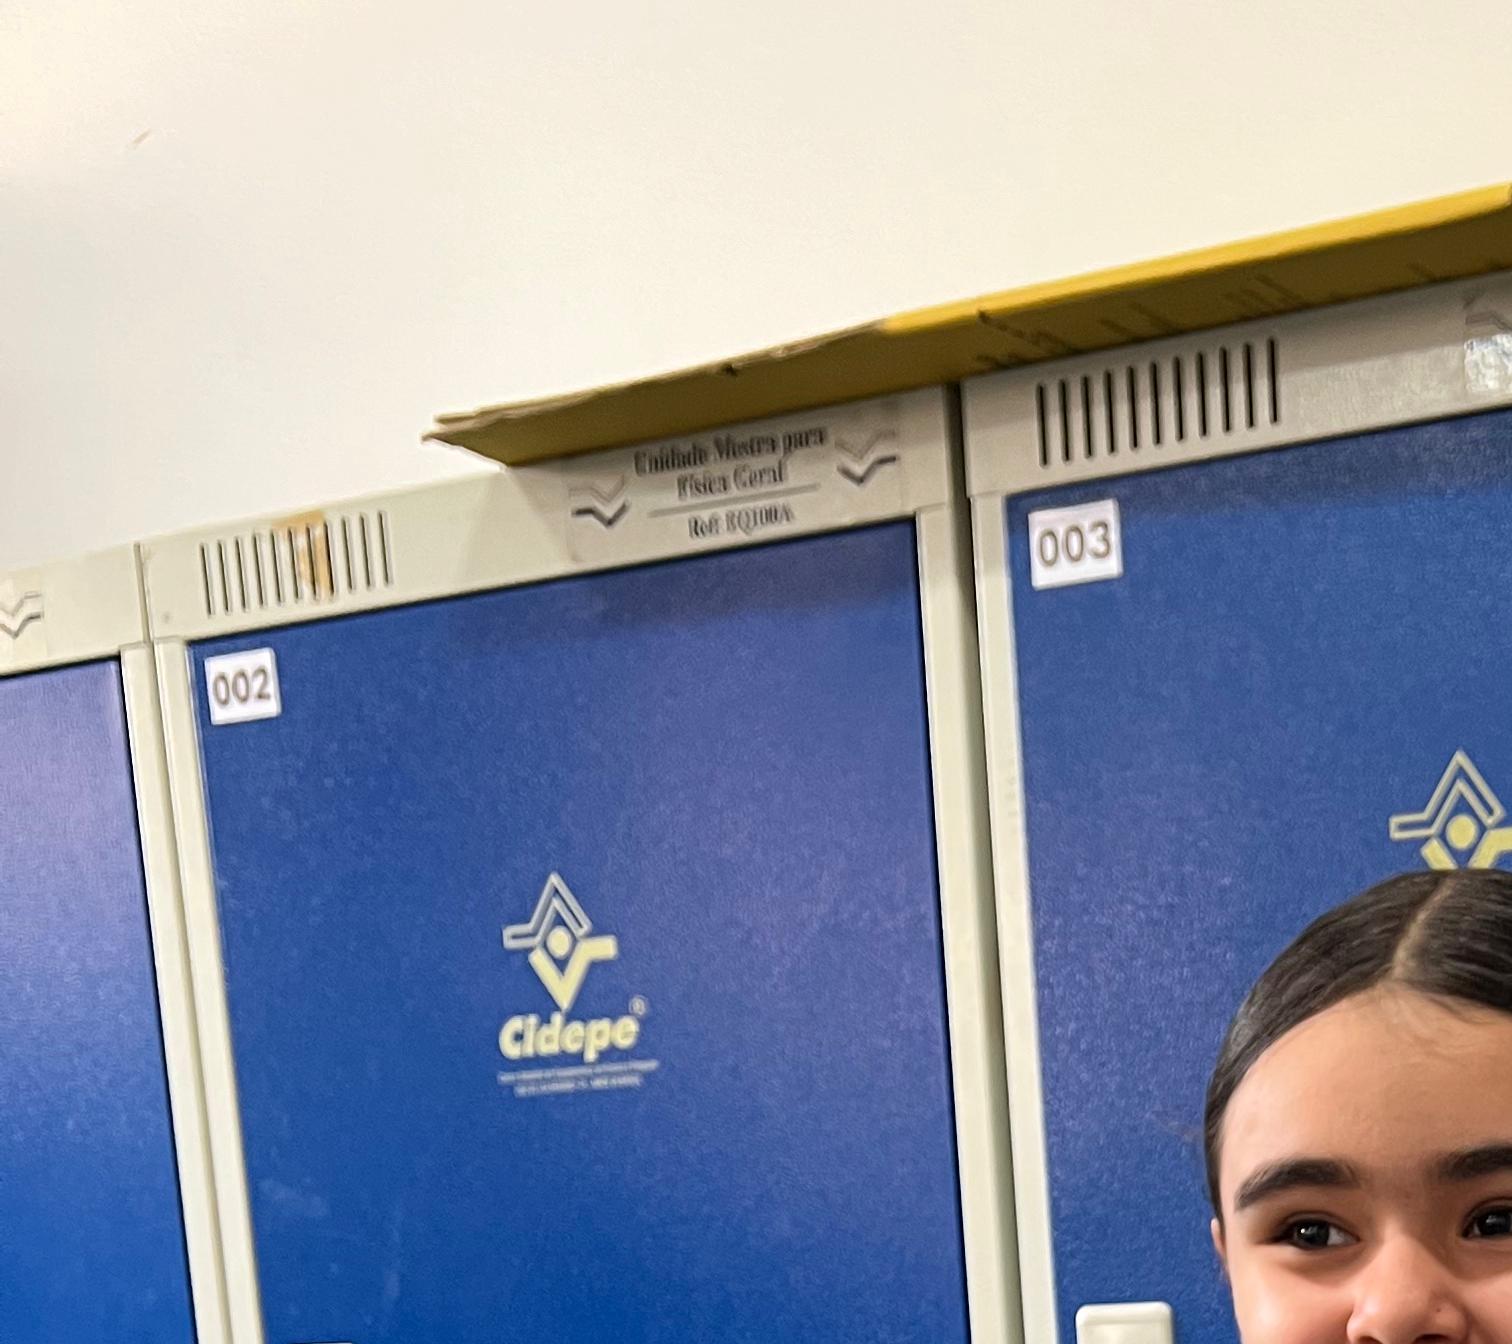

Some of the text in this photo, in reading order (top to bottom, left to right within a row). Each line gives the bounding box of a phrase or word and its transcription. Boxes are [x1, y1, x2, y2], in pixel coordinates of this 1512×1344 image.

[633, 444, 707, 477] Unidade
[782, 425, 828, 459] para
[732, 461, 786, 490] Geral
[1038, 519, 1111, 568] 003
[213, 664, 271, 707] 002
